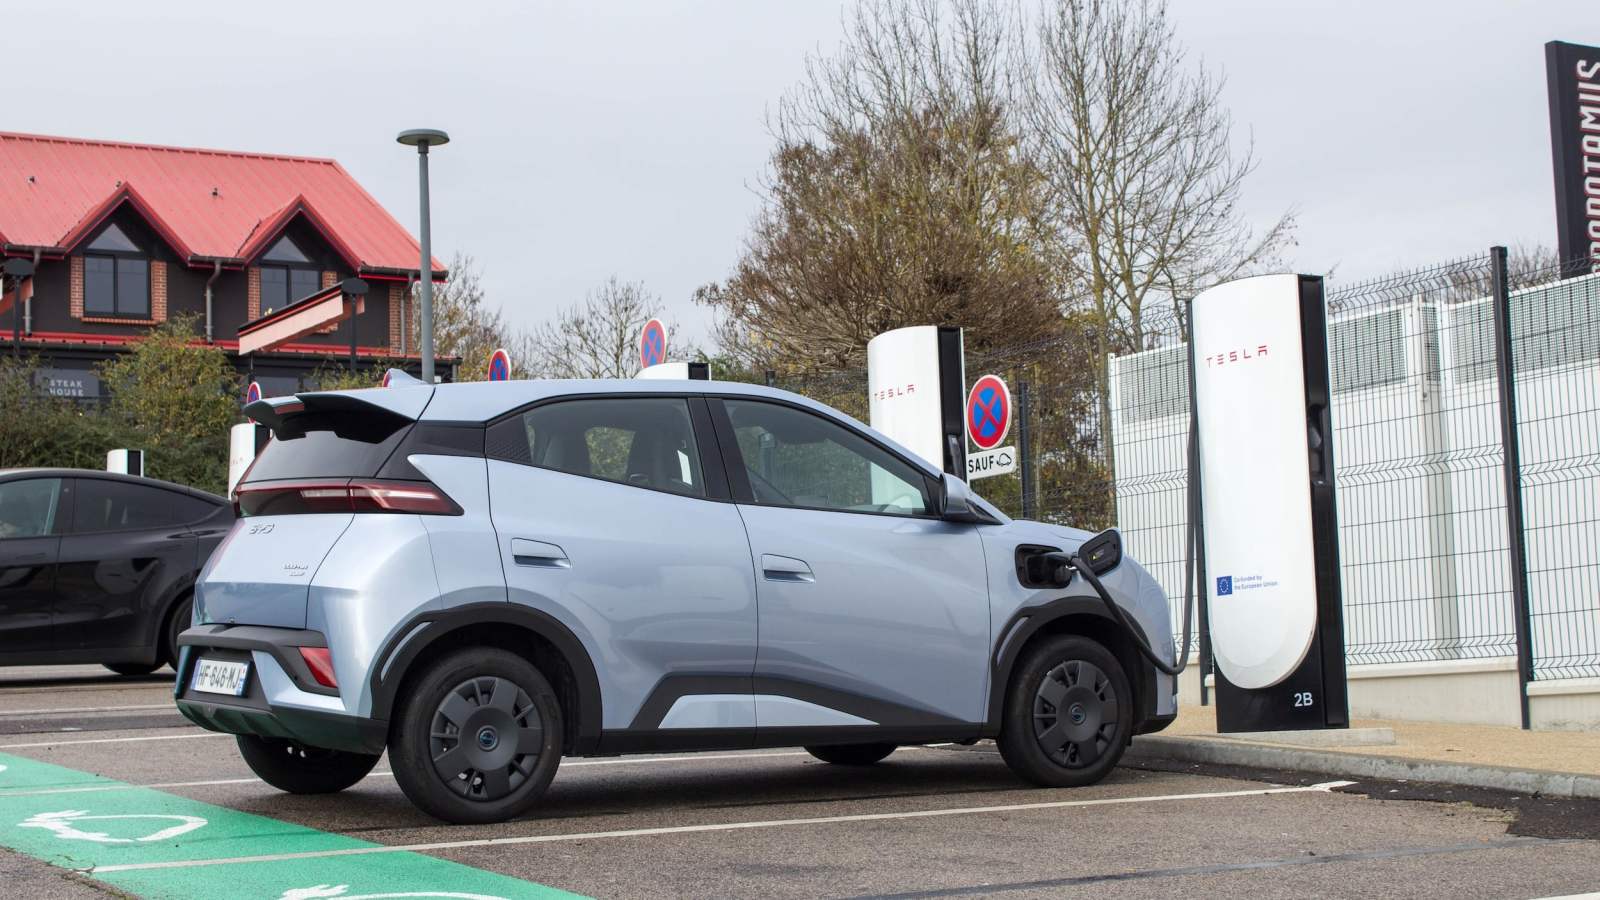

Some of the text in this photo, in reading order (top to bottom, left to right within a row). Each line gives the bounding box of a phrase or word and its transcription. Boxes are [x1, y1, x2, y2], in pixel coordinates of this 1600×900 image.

[1206, 345, 1268, 368] TESLA
[50, 380, 83, 388] STEAK
[50, 388, 84, 397] HOUSE
[874, 384, 915, 403] TESLA
[968, 455, 995, 473] SAUF
[1294, 692, 1313, 707] 2B
